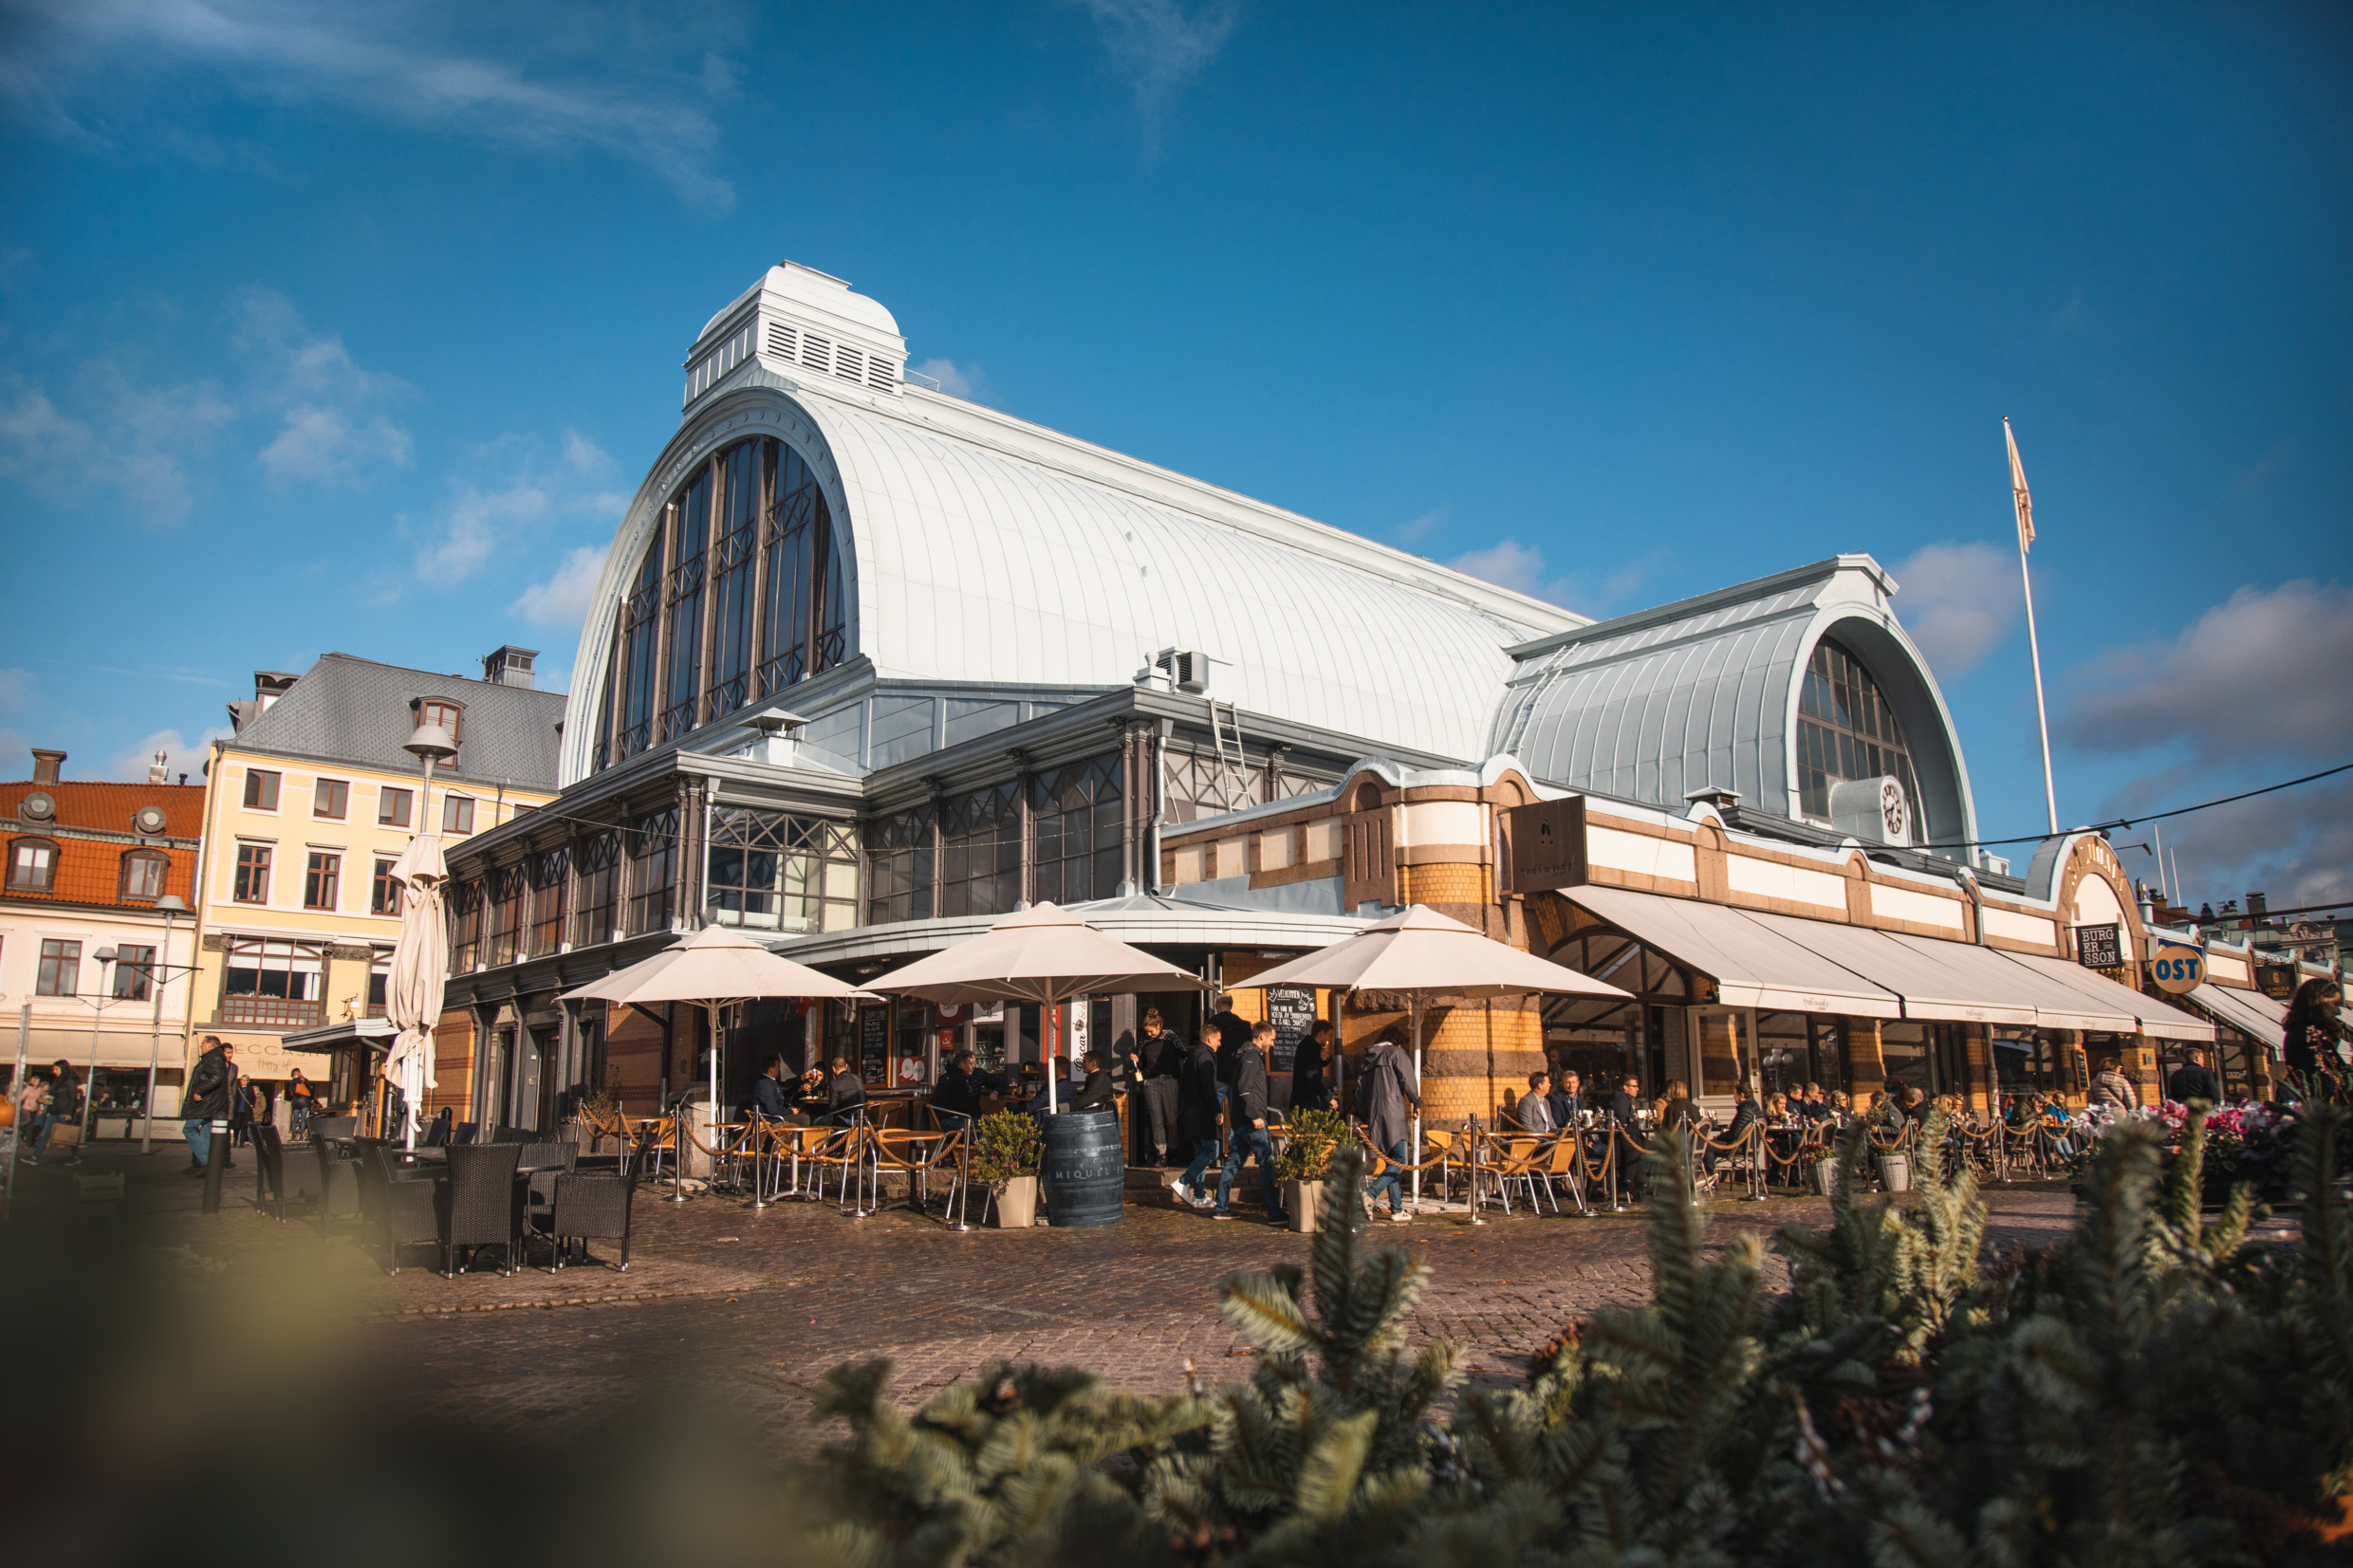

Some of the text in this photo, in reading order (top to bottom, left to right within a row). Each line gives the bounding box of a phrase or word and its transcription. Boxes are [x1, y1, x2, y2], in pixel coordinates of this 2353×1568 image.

[2082, 929, 2115, 942] BURG
[2083, 942, 2100, 953] ER
[2084, 951, 2117, 964] SSON
[2156, 959, 2198, 980] OST
[2272, 971, 2280, 984] G
[1055, 1167, 1110, 1179] MIQUEL
